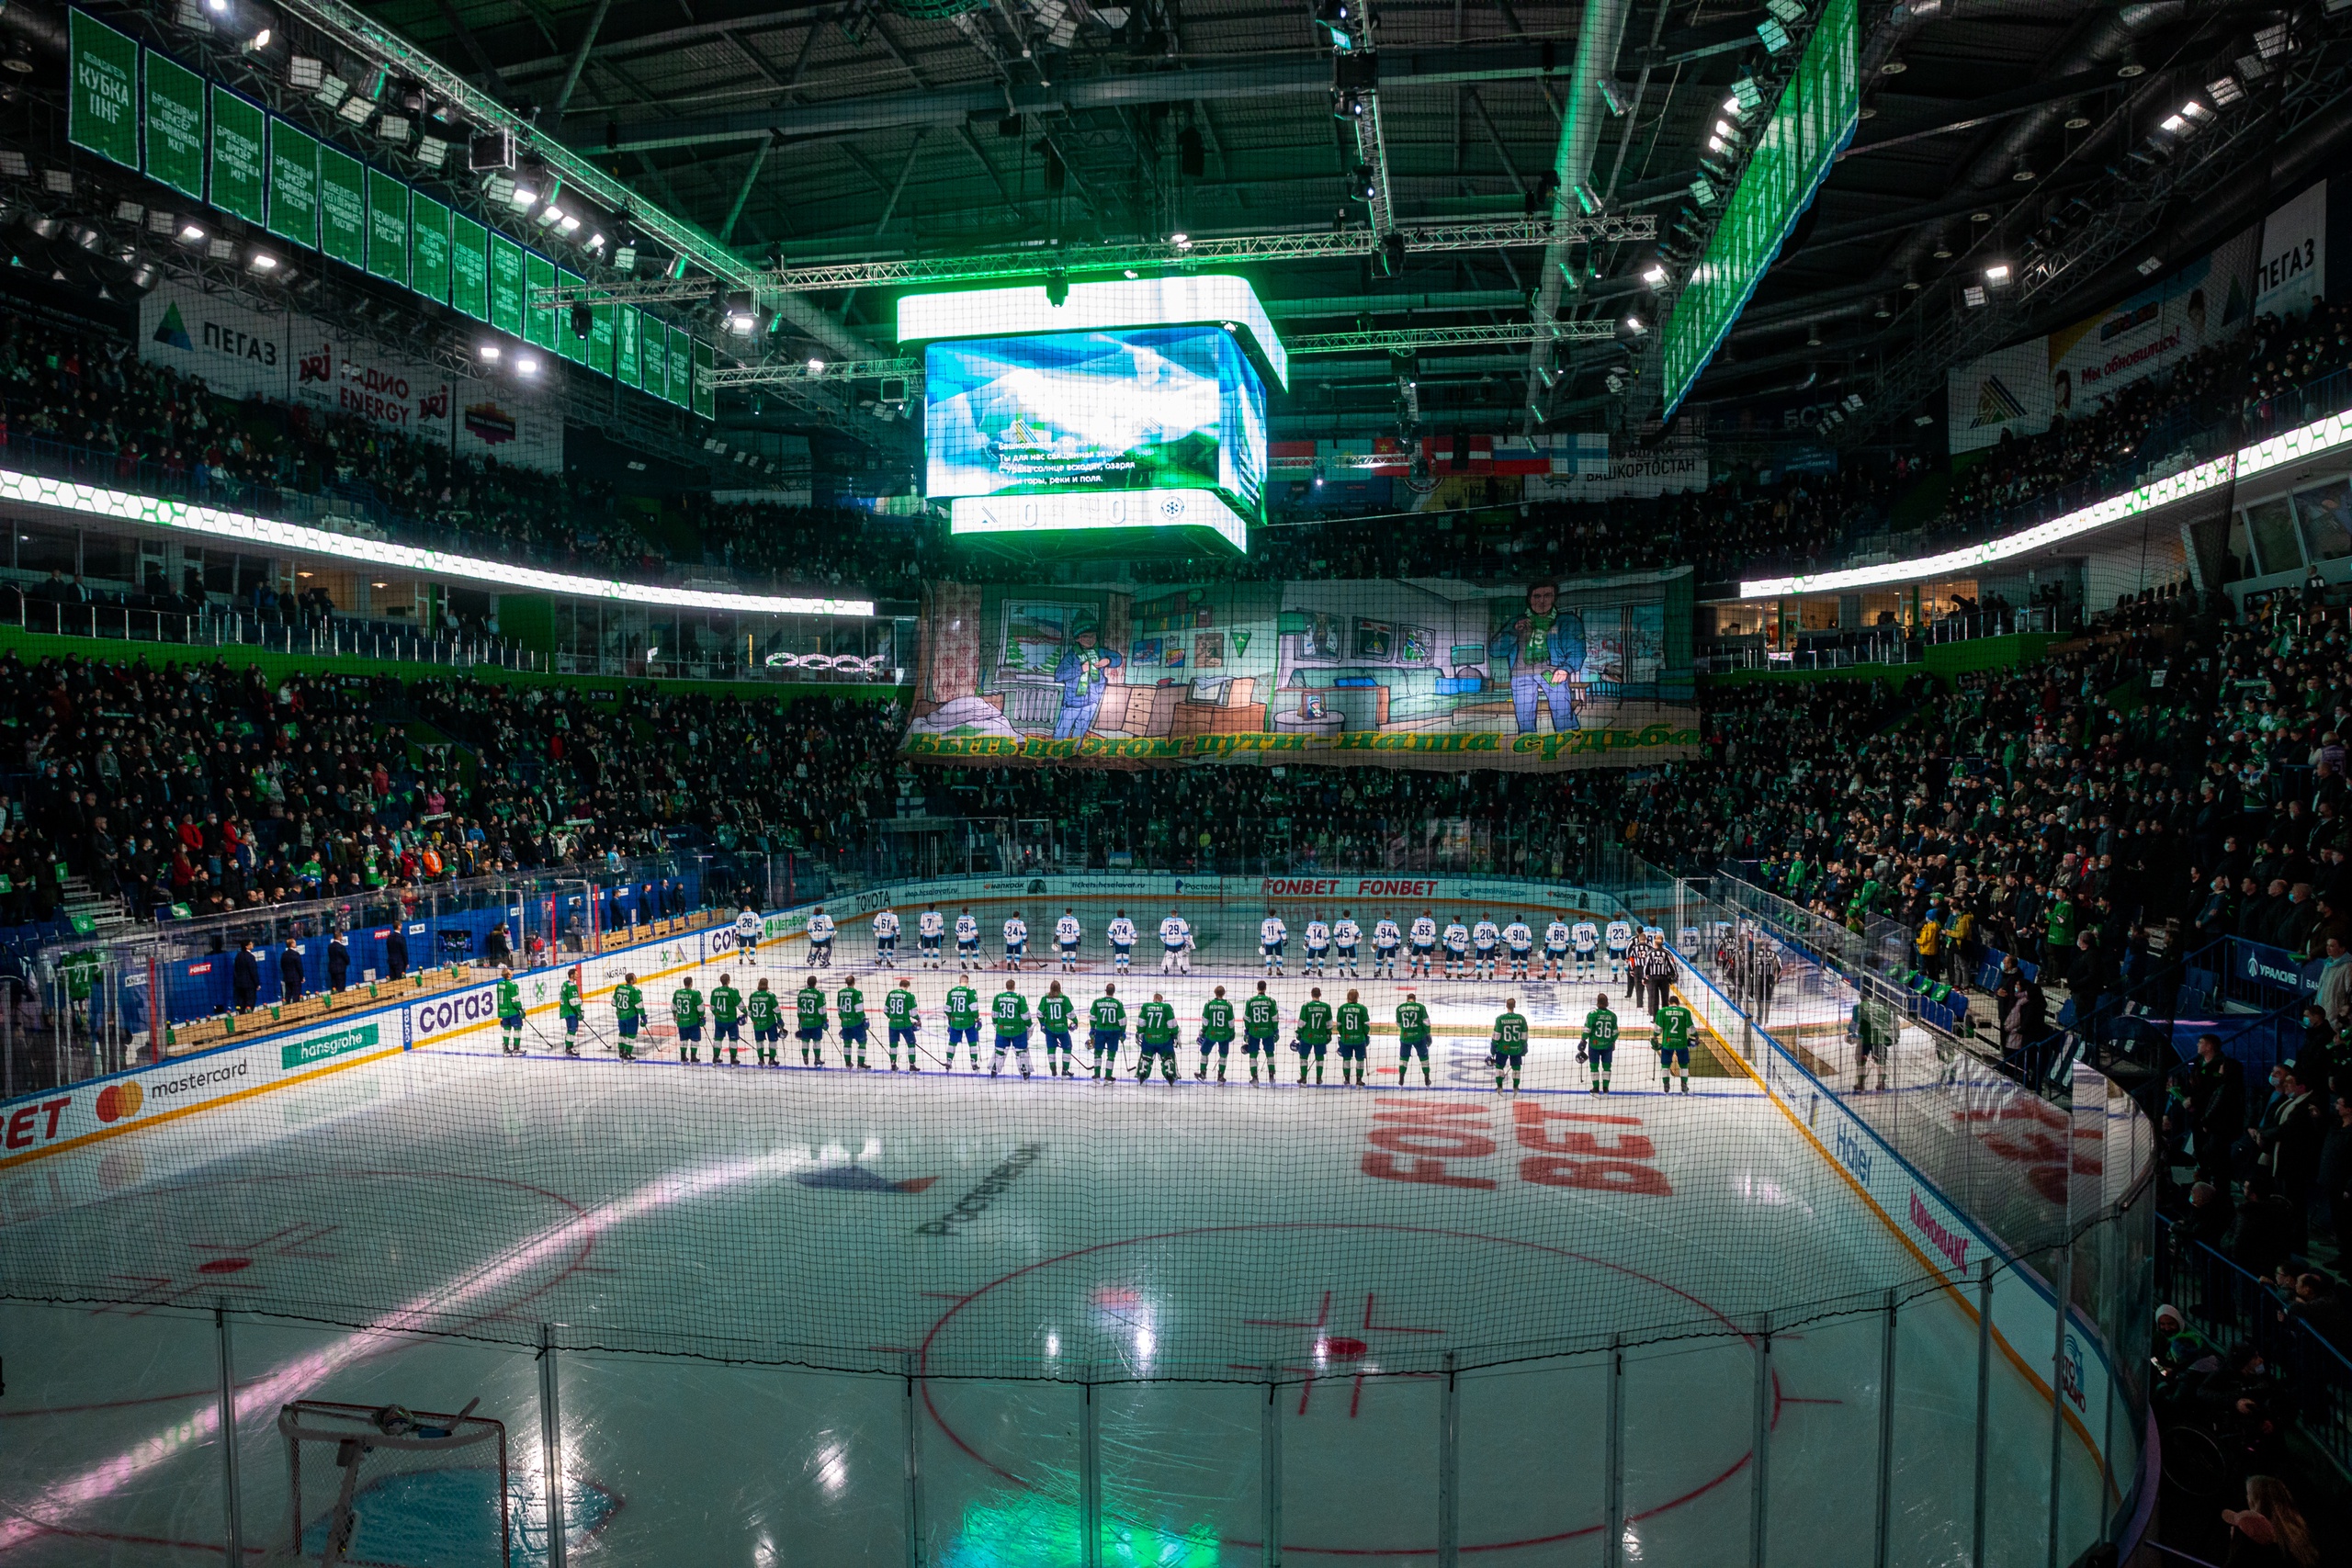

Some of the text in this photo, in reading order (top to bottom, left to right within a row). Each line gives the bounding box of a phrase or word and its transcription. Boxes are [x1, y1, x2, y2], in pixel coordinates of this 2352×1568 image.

[79, 62, 129, 107] КУБКА
[90, 93, 120, 124] IIHF
[152, 92, 198, 124] БРОНЗОВЫЙ
[2259, 239, 2313, 291] ПЕГАЗ
[204, 321, 276, 366] ПЕГАЗ
[300, 344, 331, 382] NRJ
[2082, 326, 2180, 385] Мы обновились!
[341, 359, 408, 399] РАДИО
[340, 387, 410, 425] ENERGY
[419, 385, 447, 421] NRJ
[1047, 452, 1093, 461] священная
[1096, 450, 1125, 458] земля.
[1034, 463, 1064, 472] солнце
[1067, 462, 1103, 472] всходит,
[1105, 461, 1136, 470] озаряя
[1024, 477, 1047, 486] горы,
[1049, 475, 1070, 485] реки
[1080, 474, 1102, 483] поля.
[1022, 501, 1038, 527] 0
[1108, 497, 1126, 525] 0
[340, 677, 345, 686] 4
[905, 887, 958, 898] shop.hcsalavat.ru
[1071, 881, 1145, 889] tickets.hcsalavat.ru
[1261, 879, 1340, 895] FONBET
[1358, 880, 1438, 897] FONBET
[856, 891, 890, 911] TOYOTA
[742, 919, 752, 928] 28
[813, 921, 822, 931] 35
[881, 919, 890, 930] 61
[927, 919, 932, 929] 7
[1061, 924, 1072, 934] 33
[1116, 925, 1127, 935] 74
[1168, 924, 1180, 935] 29
[1268, 926, 1274, 935] 11
[1419, 925, 1430, 935] 65
[1007, 926, 1018, 937] 24
[1313, 929, 1322, 940] 14
[1340, 928, 1350, 938] 45
[1381, 928, 1392, 939] 94
[1453, 931, 1464, 942] 22
[1480, 930, 1490, 940] 20
[1513, 930, 1524, 941] 90
[1554, 930, 1565, 941] 86
[1580, 931, 1589, 942] 10
[1612, 929, 1624, 940] 23
[1638, 949, 1645, 957] 12
[74, 964, 89, 984] 27
[604, 967, 627, 979] INGRAD
[2260, 964, 2297, 985] УРАЛСИБ
[616, 995, 628, 1009] 26
[676, 999, 689, 1014] 93
[716, 998, 726, 1011] 41
[801, 998, 814, 1013] 33
[840, 998, 852, 1012] 48
[889, 999, 903, 1014] 98
[952, 998, 965, 1012] 78
[419, 991, 494, 1032] согаз
[752, 1003, 766, 1017] 92
[1000, 1003, 1014, 1019] 39
[1050, 1004, 1061, 1019] 10
[1100, 1009, 1116, 1023] 70
[1252, 1007, 1269, 1022] 85
[1148, 1012, 1162, 1028] 77
[1213, 1011, 1225, 1027] 19
[1311, 1013, 1323, 1029] 17
[1346, 1014, 1358, 1030] 61
[1402, 1012, 1418, 1028] 62
[1671, 1018, 1679, 1033] 2
[1503, 1025, 1521, 1042] 65
[1595, 1021, 1611, 1038] 36
[301, 1032, 363, 1060] hansgrohe
[152, 1059, 247, 1099] mastercard
[0, 1097, 71, 1149] ET
[1362, 1099, 1672, 1196] FON BET
[1838, 1122, 1872, 1187] Haier
[1911, 1188, 1968, 1276] КИНОМАКС
